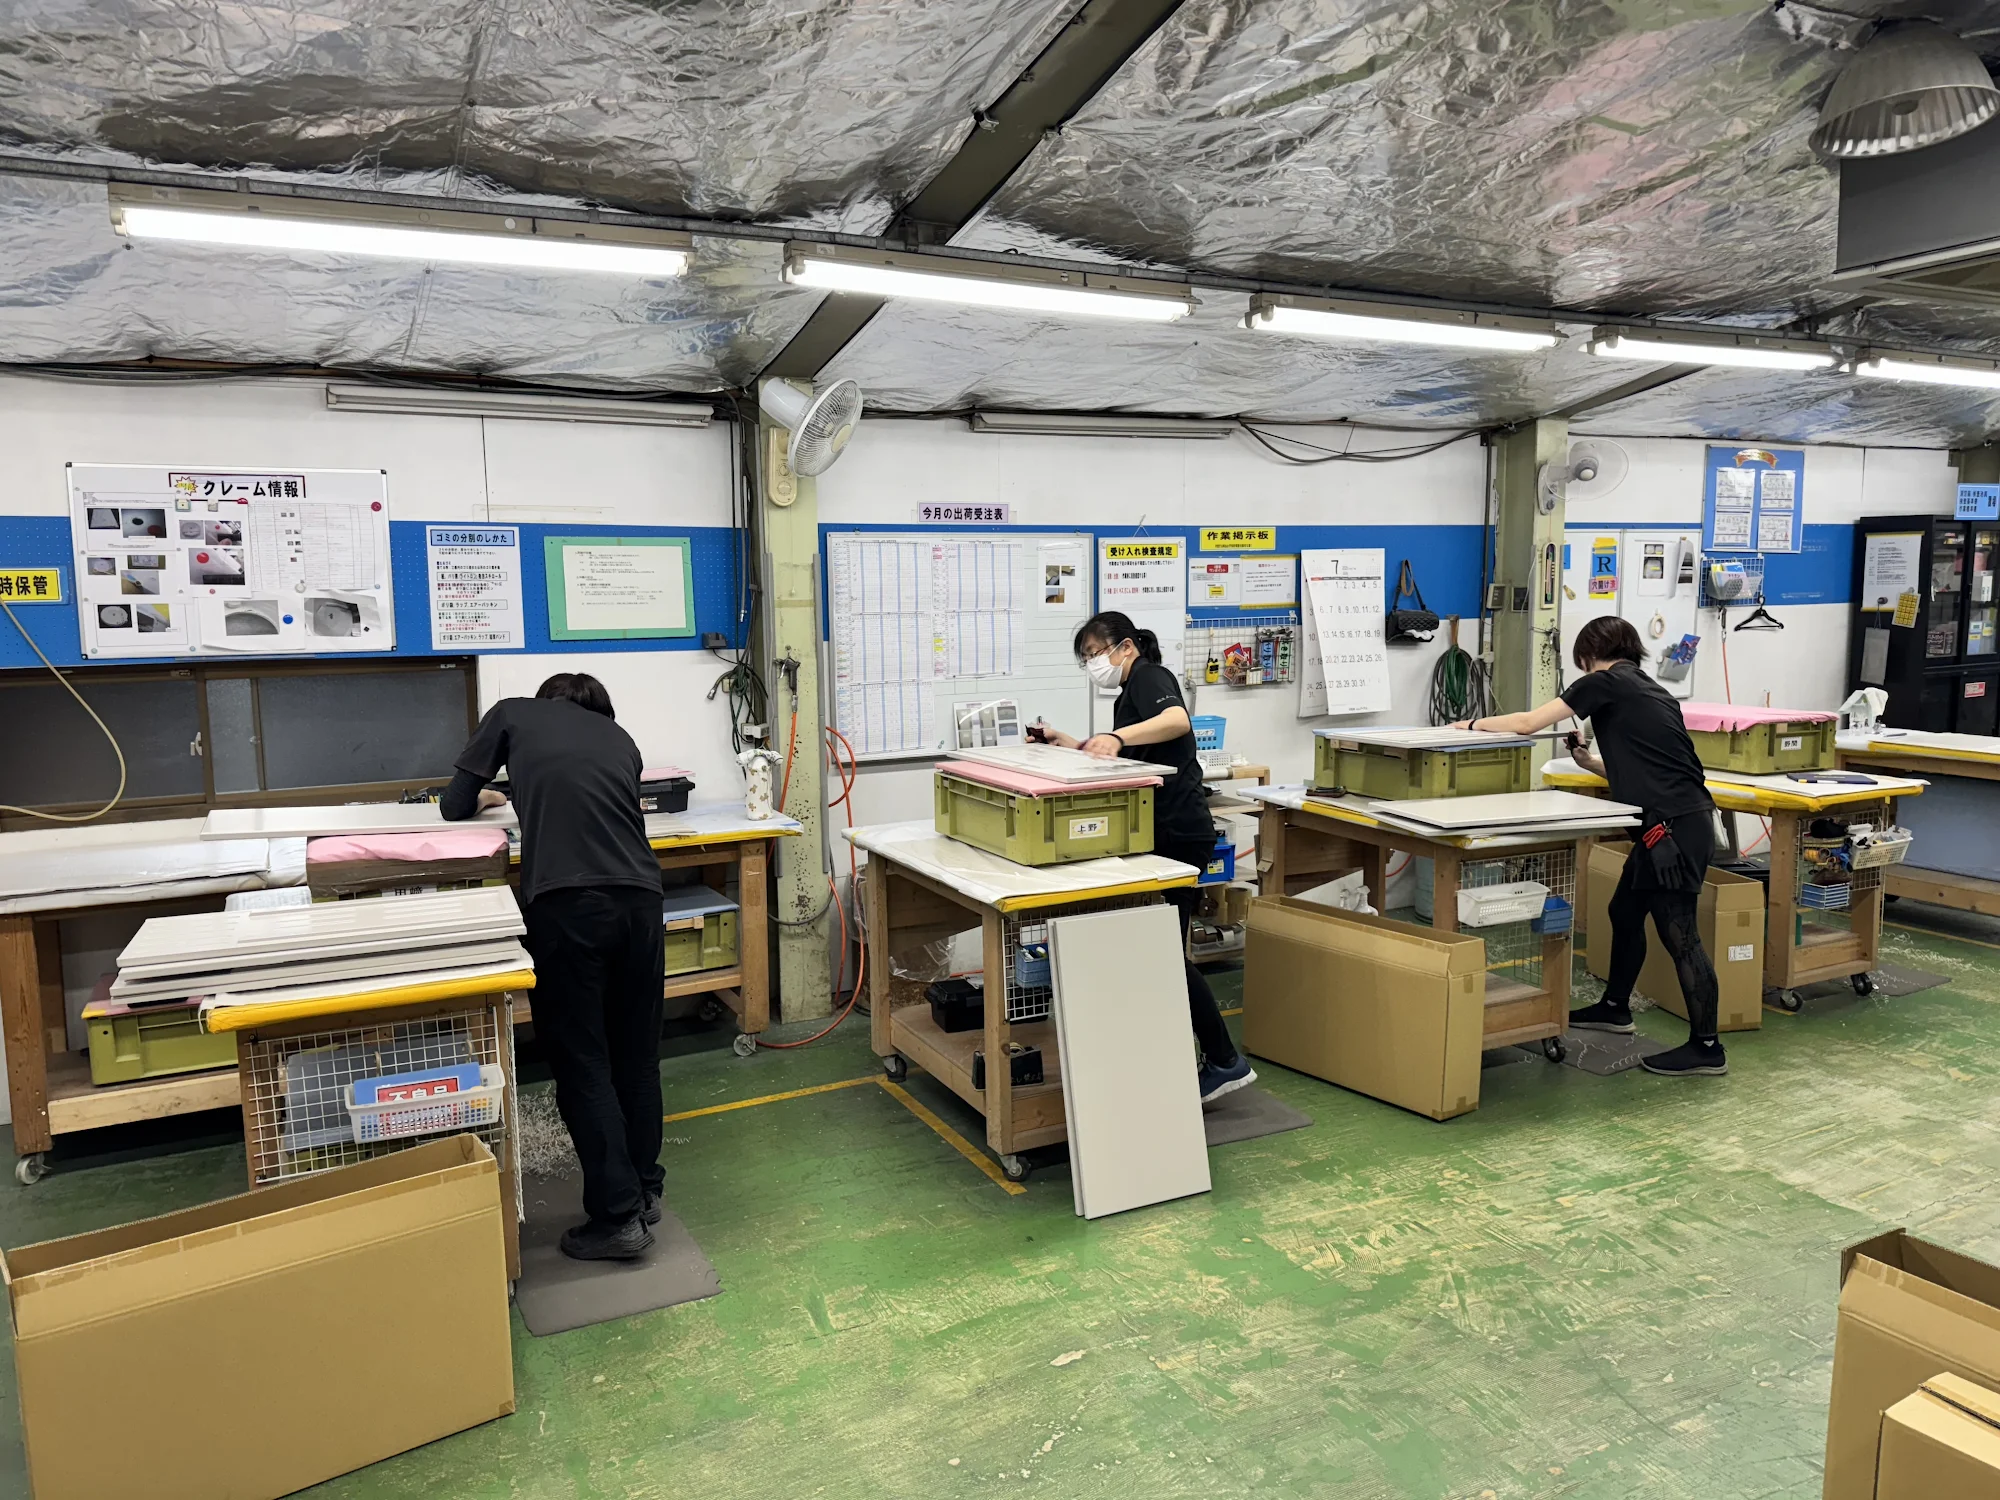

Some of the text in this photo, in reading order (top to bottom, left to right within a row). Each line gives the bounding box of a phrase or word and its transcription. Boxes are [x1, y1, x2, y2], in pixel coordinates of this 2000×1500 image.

[203, 480, 299, 498] クレーム情報
[922, 507, 1003, 520] 今月の出荷受注表
[436, 533, 508, 543] ゴミの分別のしかた
[1206, 530, 1269, 541] 作業掲示板
[1110, 546, 1173, 557] 受け入れ検査規定
[1331, 560, 1339, 574] 7
[1596, 556, 1613, 573] R
[0, 576, 48, 596] 時保管
[1591, 579, 1616, 590] 穴開け済
[1372, 605, 1380, 613] 12
[1323, 630, 1329, 638] 13
[1332, 630, 1338, 638] 14
[1355, 630, 1361, 638] 17
[1364, 630, 1371, 638] 18
[1374, 629, 1380, 638] 19
[1341, 655, 1347, 663] 22
[1349, 655, 1355, 663] 23
[1357, 655, 1363, 663] 24
[1366, 654, 1373, 662] 25
[1344, 680, 1350, 688] 29
[1077, 823, 1097, 833] 上野
